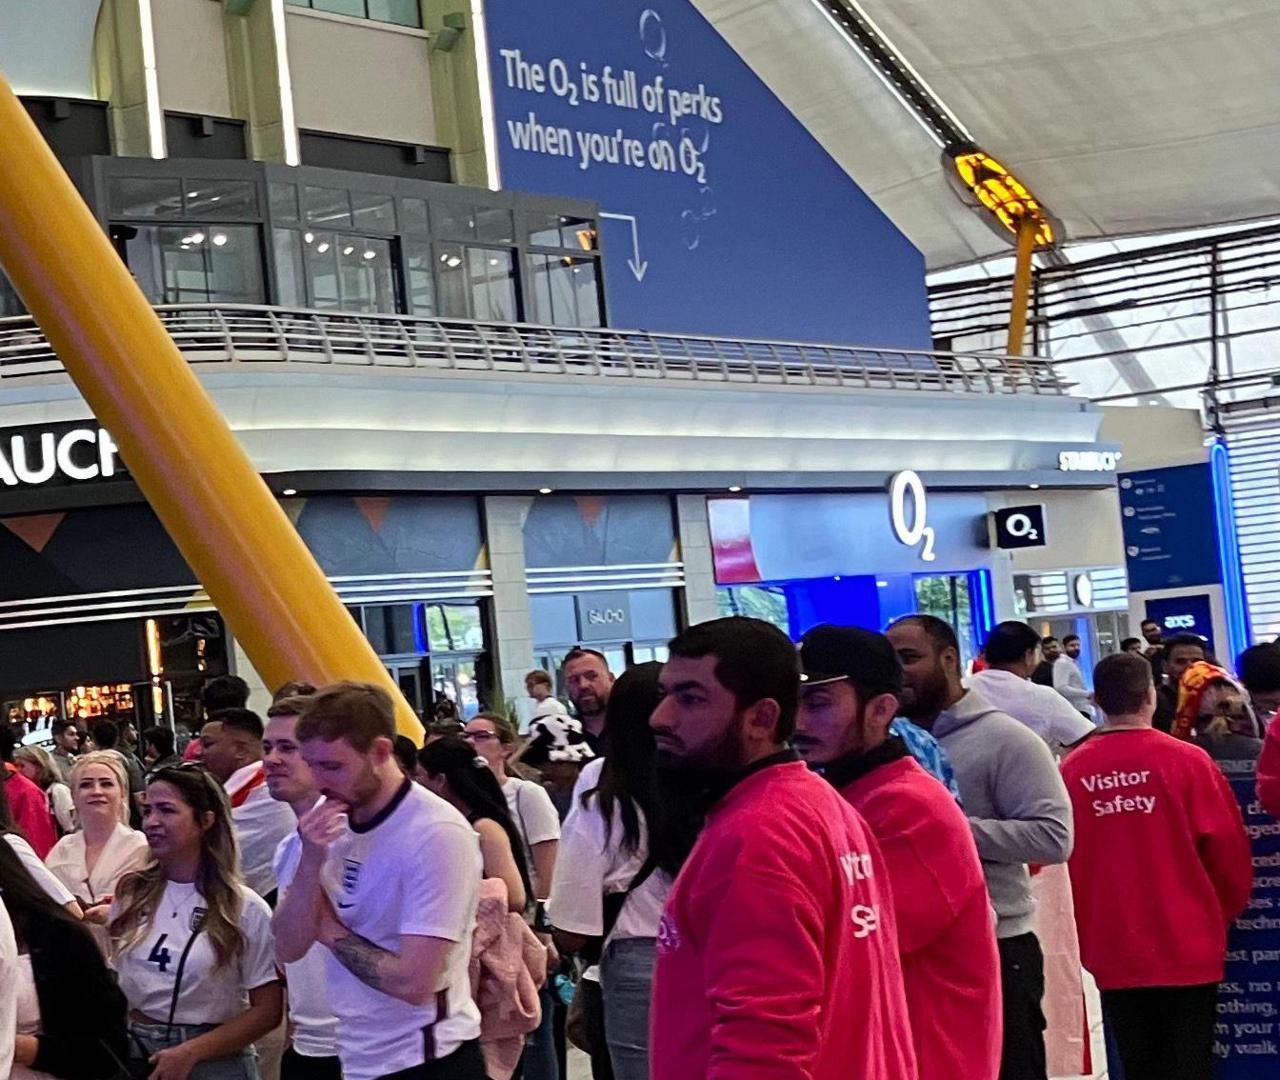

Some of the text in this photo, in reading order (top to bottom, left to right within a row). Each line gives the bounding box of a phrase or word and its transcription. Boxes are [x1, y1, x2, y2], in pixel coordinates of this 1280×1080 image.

[499, 48, 546, 93] The
[580, 62, 600, 102] is
[602, 66, 638, 109] full
[642, 76, 664, 114] of
[668, 84, 724, 126] perks
[507, 112, 574, 158] when
[577, 128, 645, 170] you're
[648, 139, 676, 172] on
[1080, 770, 1151, 792] Visitor
[1092, 795, 1156, 817] Safety
[147, 933, 172, 973] 4
